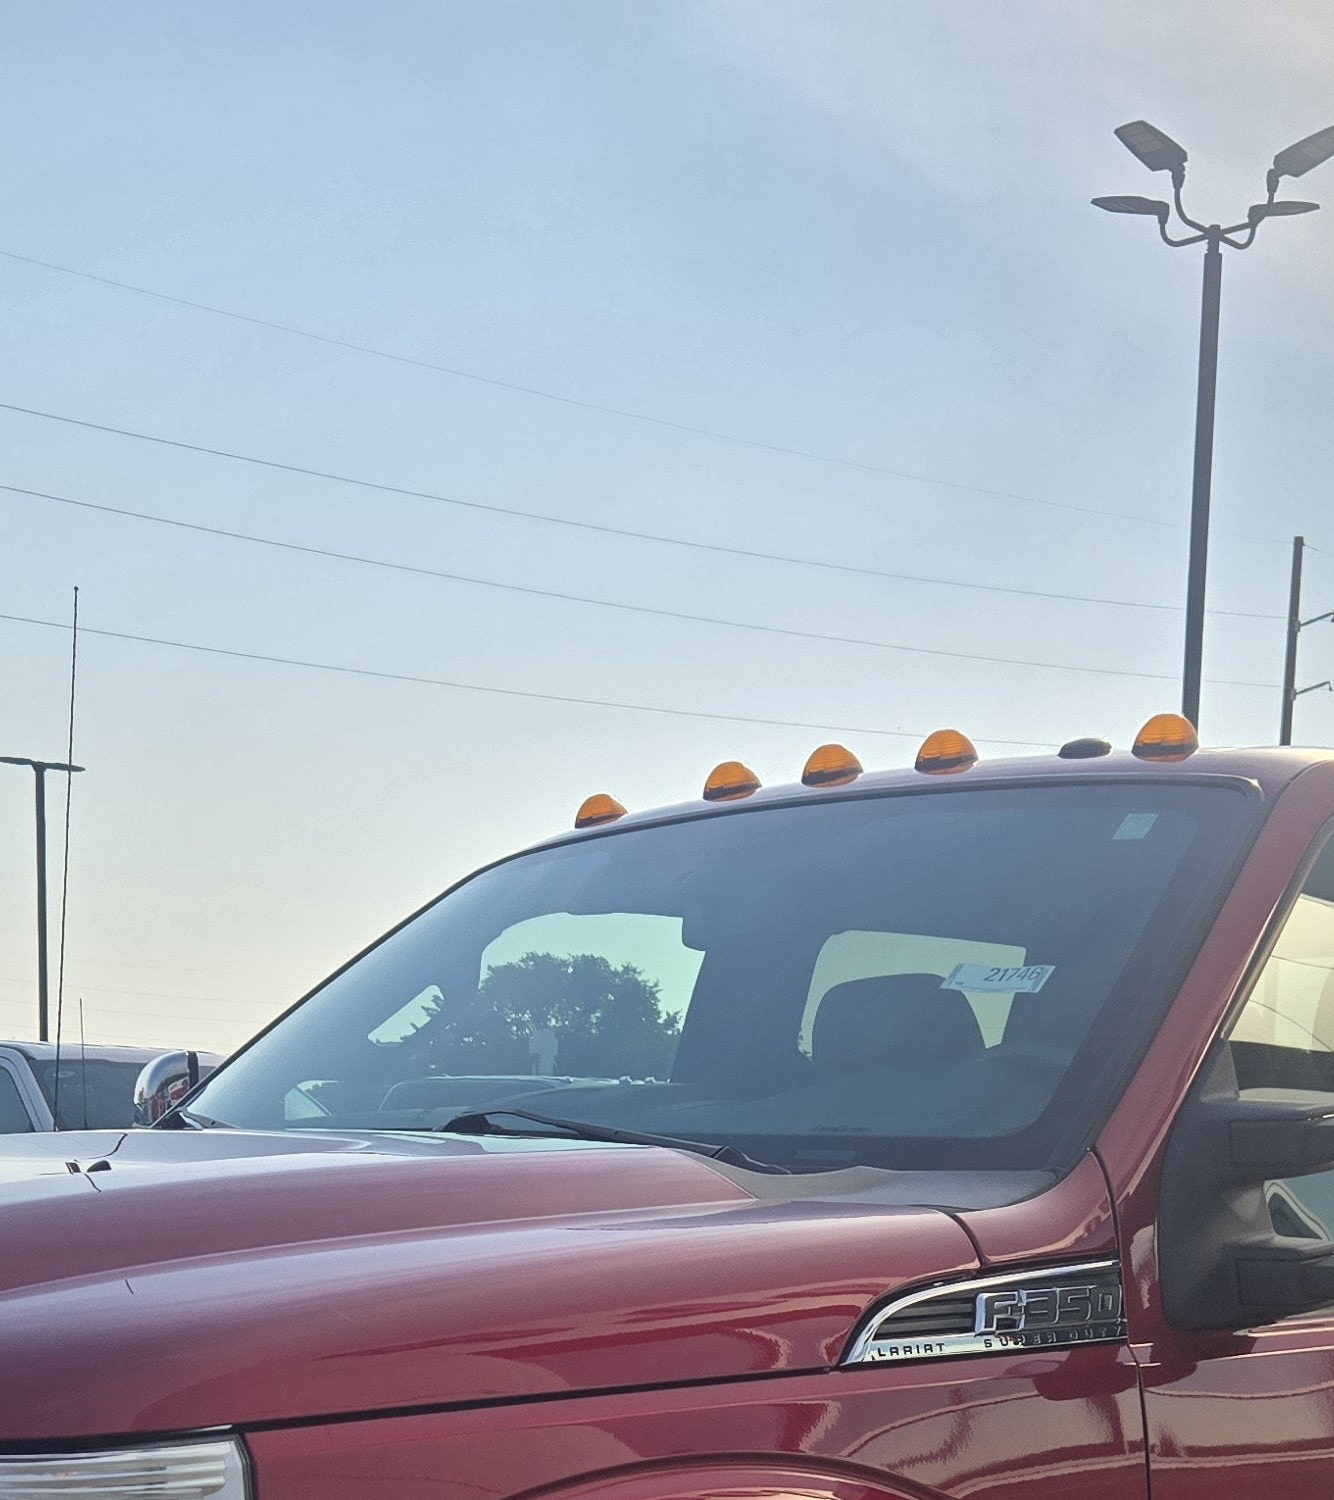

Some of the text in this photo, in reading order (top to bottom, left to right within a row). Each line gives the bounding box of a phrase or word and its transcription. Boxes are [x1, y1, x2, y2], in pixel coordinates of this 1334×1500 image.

[984, 967, 1042, 982] 21746
[877, 1343, 945, 1358] LARIAT
[984, 1332, 1057, 1349] SUPER
